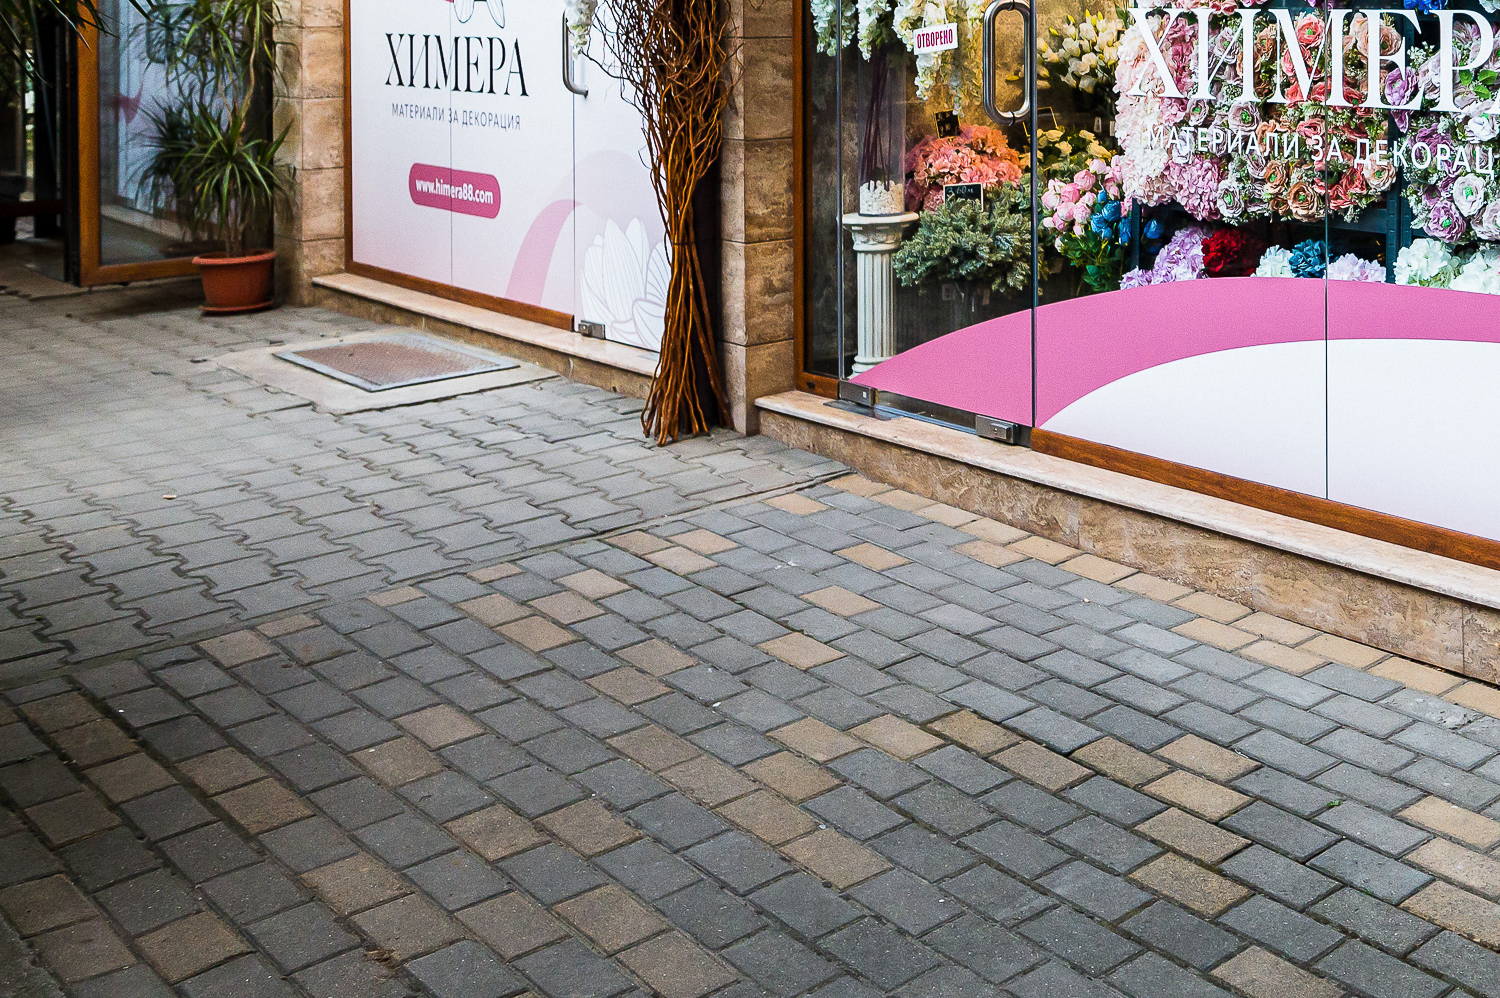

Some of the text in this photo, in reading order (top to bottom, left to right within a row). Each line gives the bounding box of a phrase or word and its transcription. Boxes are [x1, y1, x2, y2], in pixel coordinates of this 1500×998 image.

[916, 28, 954, 49] ОТВОРЕНО
[385, 33, 530, 97] ХИМЕРА
[391, 103, 521, 131] МАТЕРИАЛИ ЗА ДЕКОРАЦИЯ
[1147, 124, 1301, 160] МАТЕРИАЛИ
[1311, 134, 1344, 163] ЗА
[415, 177, 494, 205] www.himera88.com
